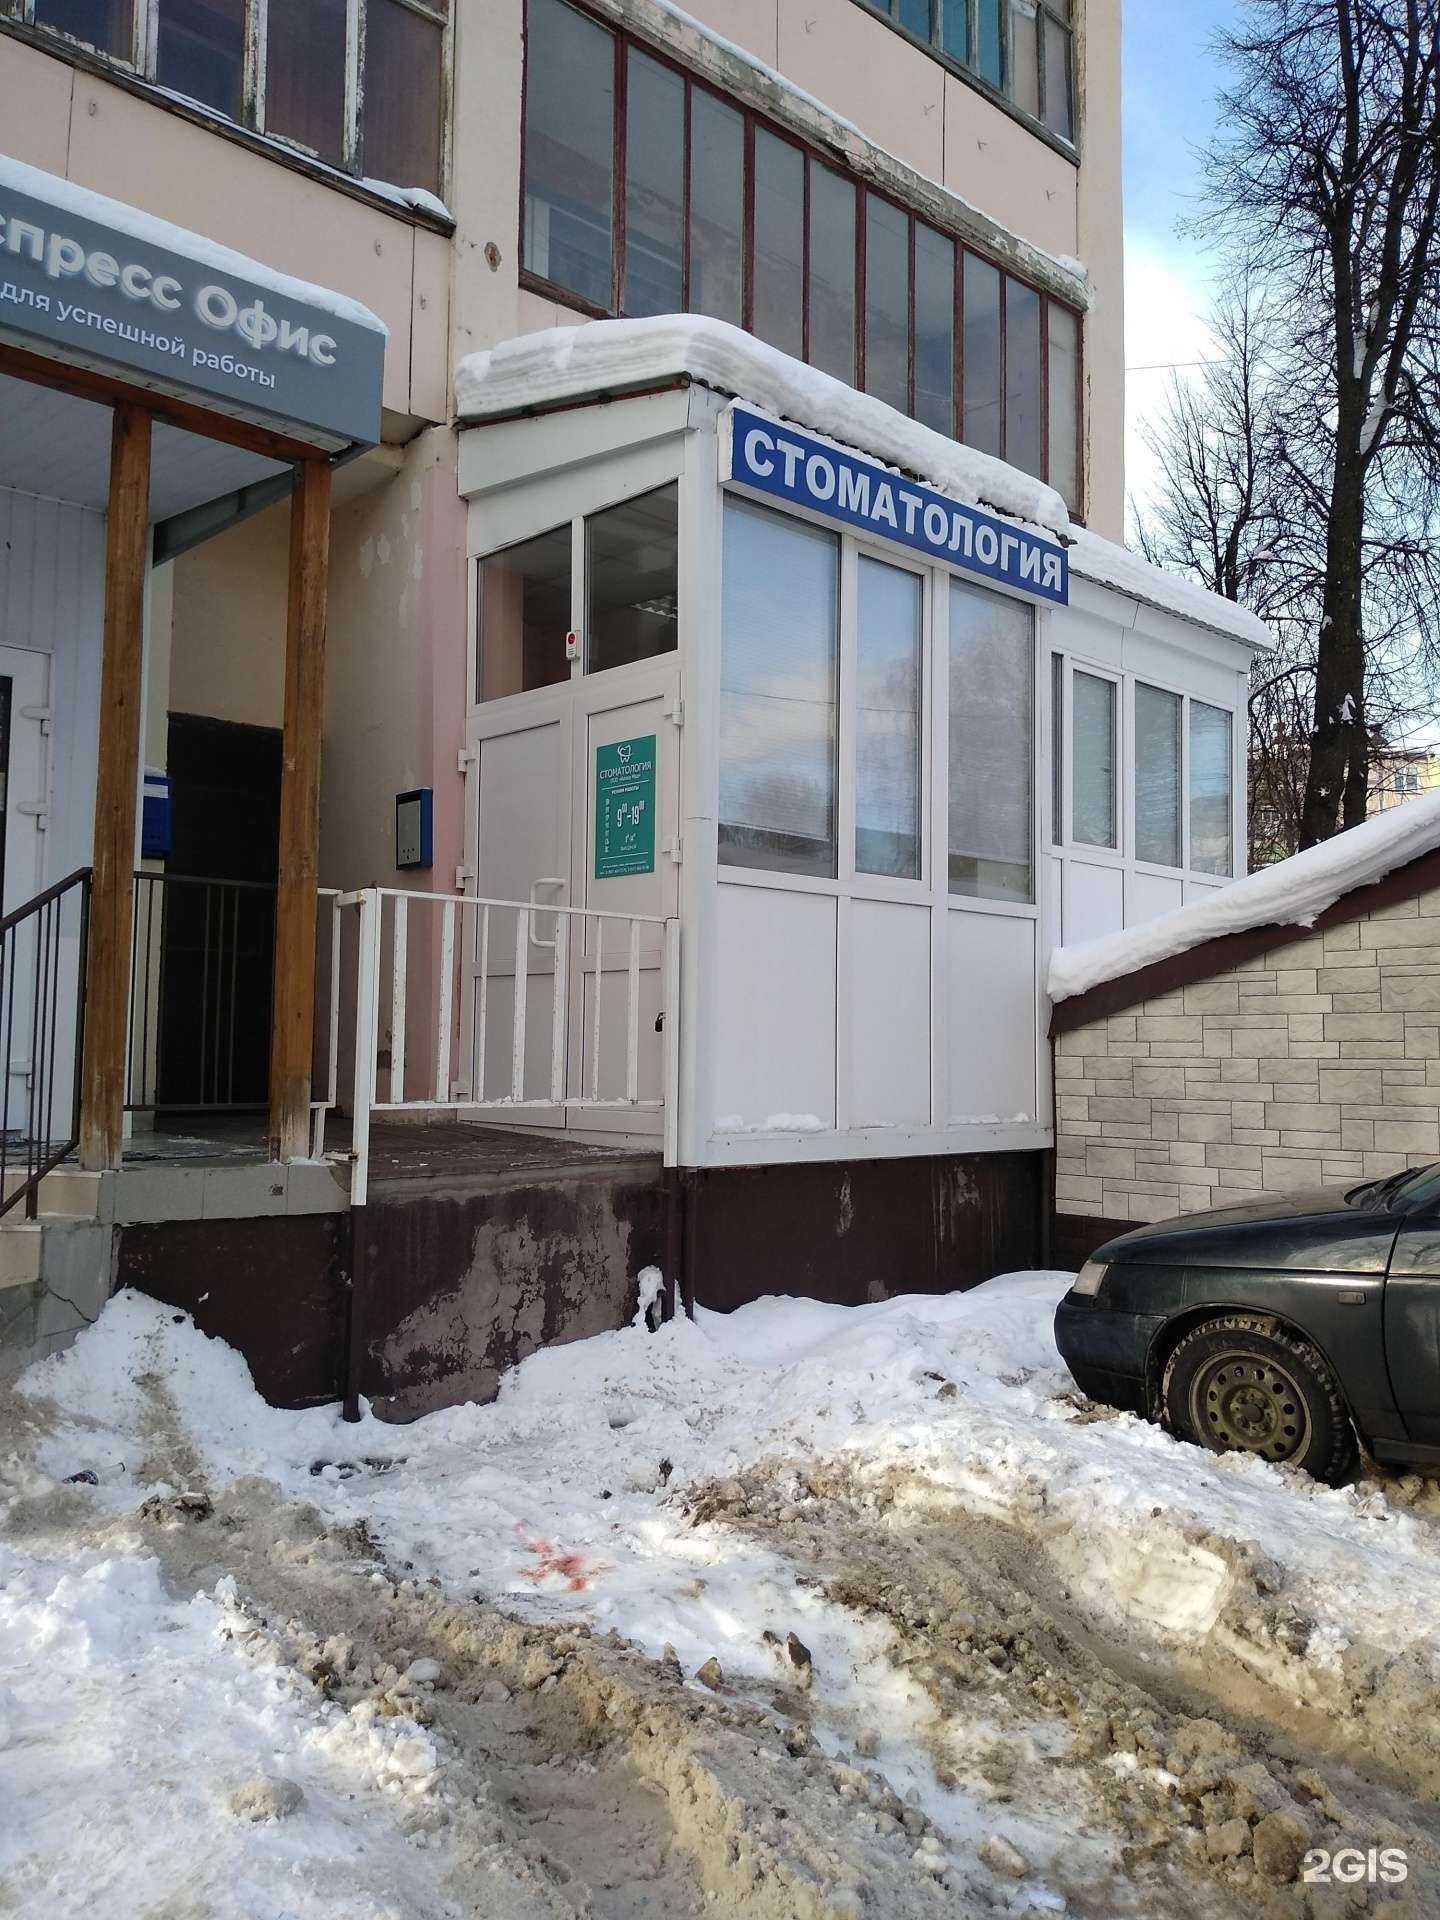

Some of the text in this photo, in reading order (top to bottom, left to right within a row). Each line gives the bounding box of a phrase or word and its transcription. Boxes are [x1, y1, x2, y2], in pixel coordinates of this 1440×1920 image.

[0, 213, 338, 367] пресс Офис
[0, 281, 276, 390] для успешной работы
[744, 429, 1062, 592] СТОМАТОЛОГИЯ
[600, 761, 651, 779] СТОМАТОЛОГИЯ
